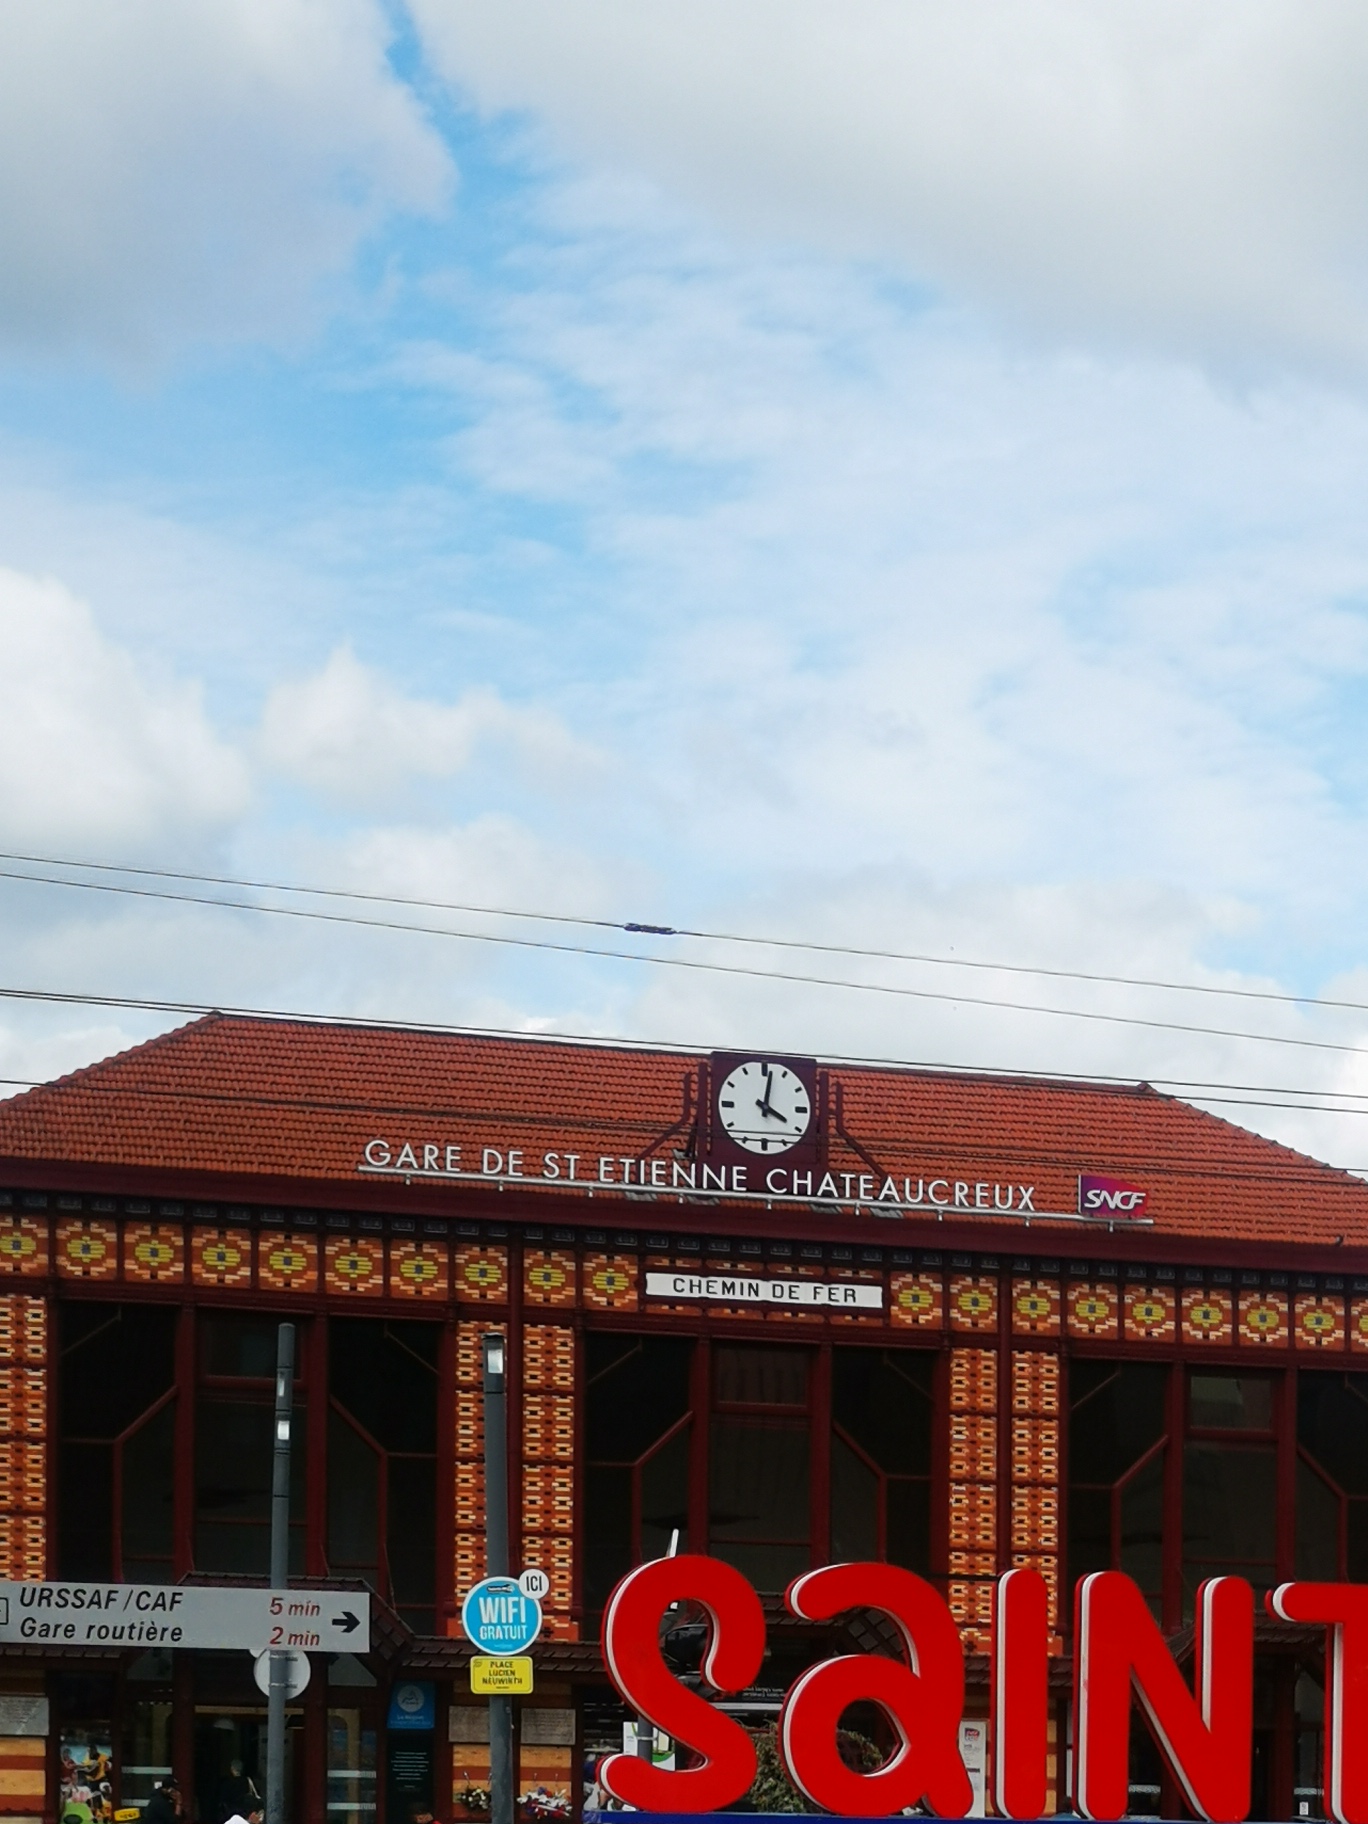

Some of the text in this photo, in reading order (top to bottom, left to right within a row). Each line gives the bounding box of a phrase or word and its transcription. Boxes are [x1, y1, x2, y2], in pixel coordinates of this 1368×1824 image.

[364, 1139, 1036, 1211] GARE DE ST ETIENNE CHATEAUCREUX
[1083, 1188, 1147, 1211] SNCF
[672, 1277, 858, 1303] CHEMIN DE FER
[525, 1575, 543, 1592] ICI
[269, 1597, 284, 1616] 5
[288, 1598, 321, 1617] min
[478, 1596, 527, 1624] WIFI
[20, 1617, 320, 1647] Gare routière 2 min
[479, 1625, 528, 1640] GRATUIT
